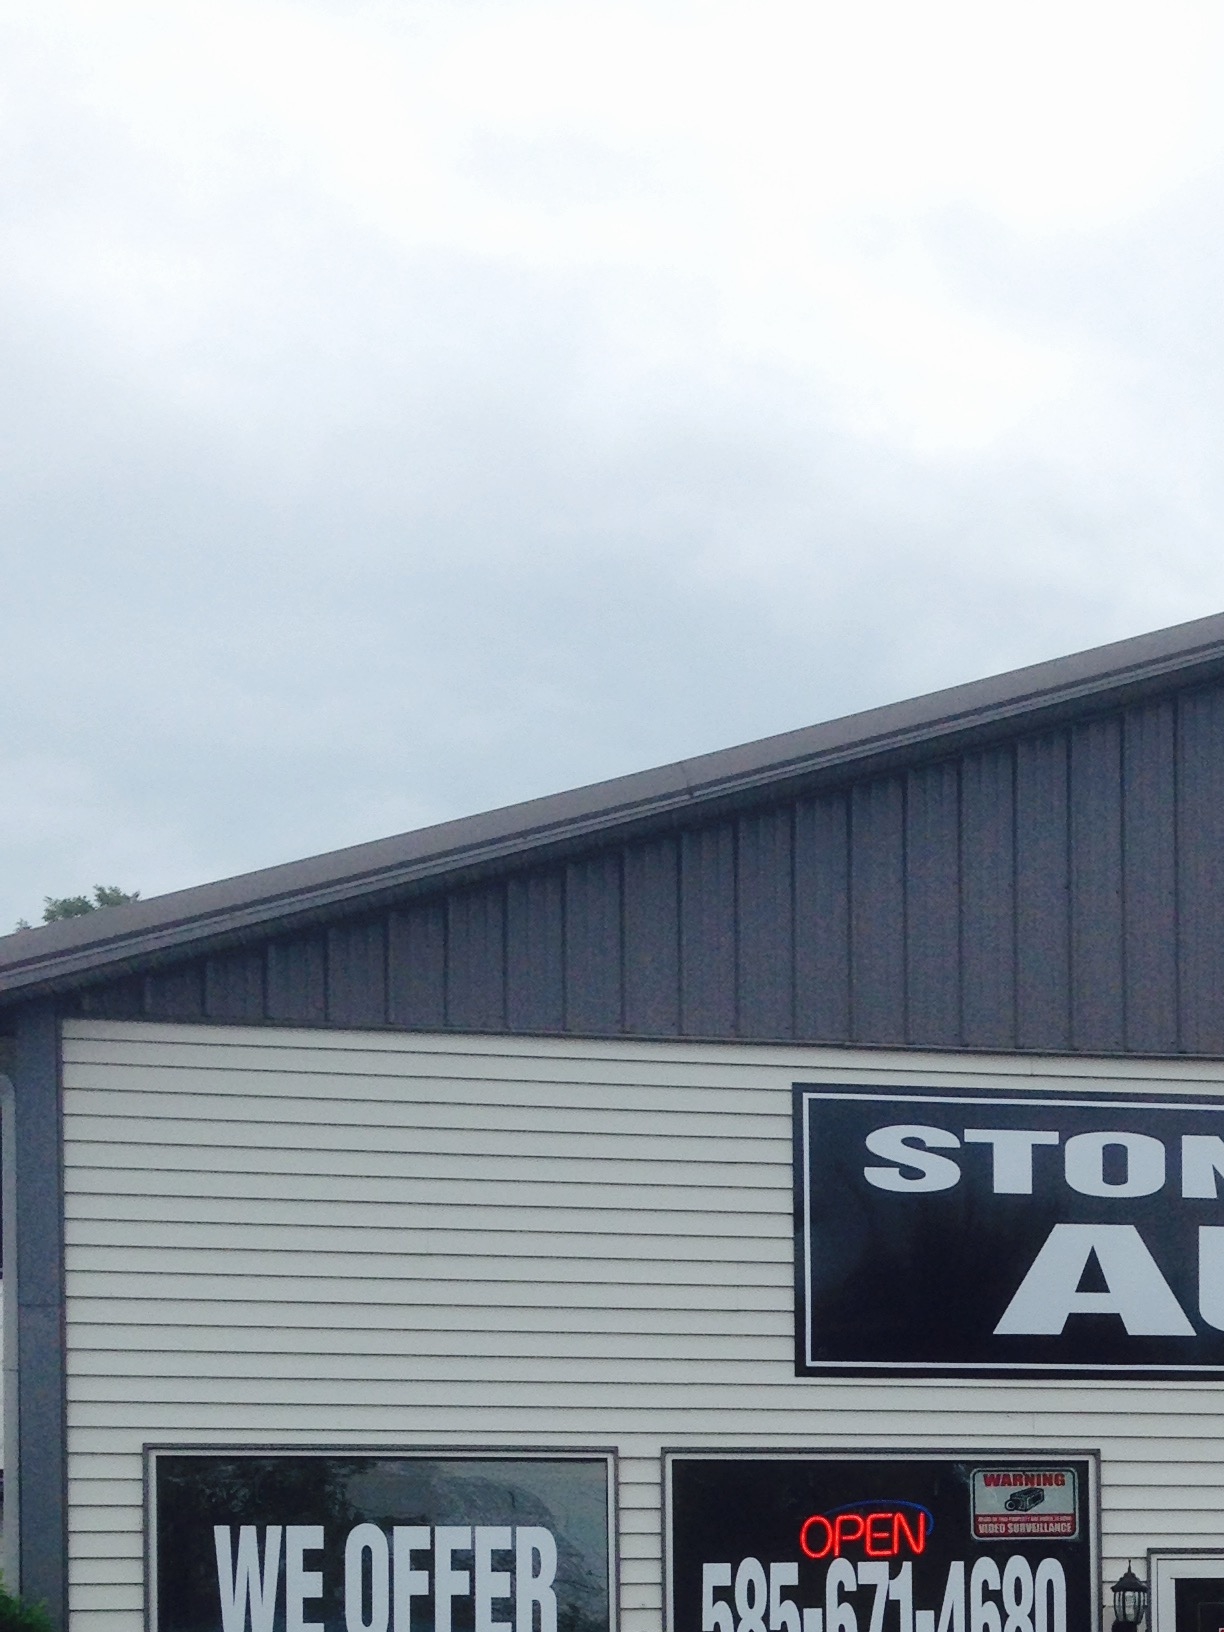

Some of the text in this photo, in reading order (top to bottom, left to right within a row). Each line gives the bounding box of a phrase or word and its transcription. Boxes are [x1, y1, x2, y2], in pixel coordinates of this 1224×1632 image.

[983, 1473, 1065, 1486] WARNING
[978, 1522, 1072, 1534] VIDEO SURVEILLANCE
[801, 1513, 926, 1558] OPEN
